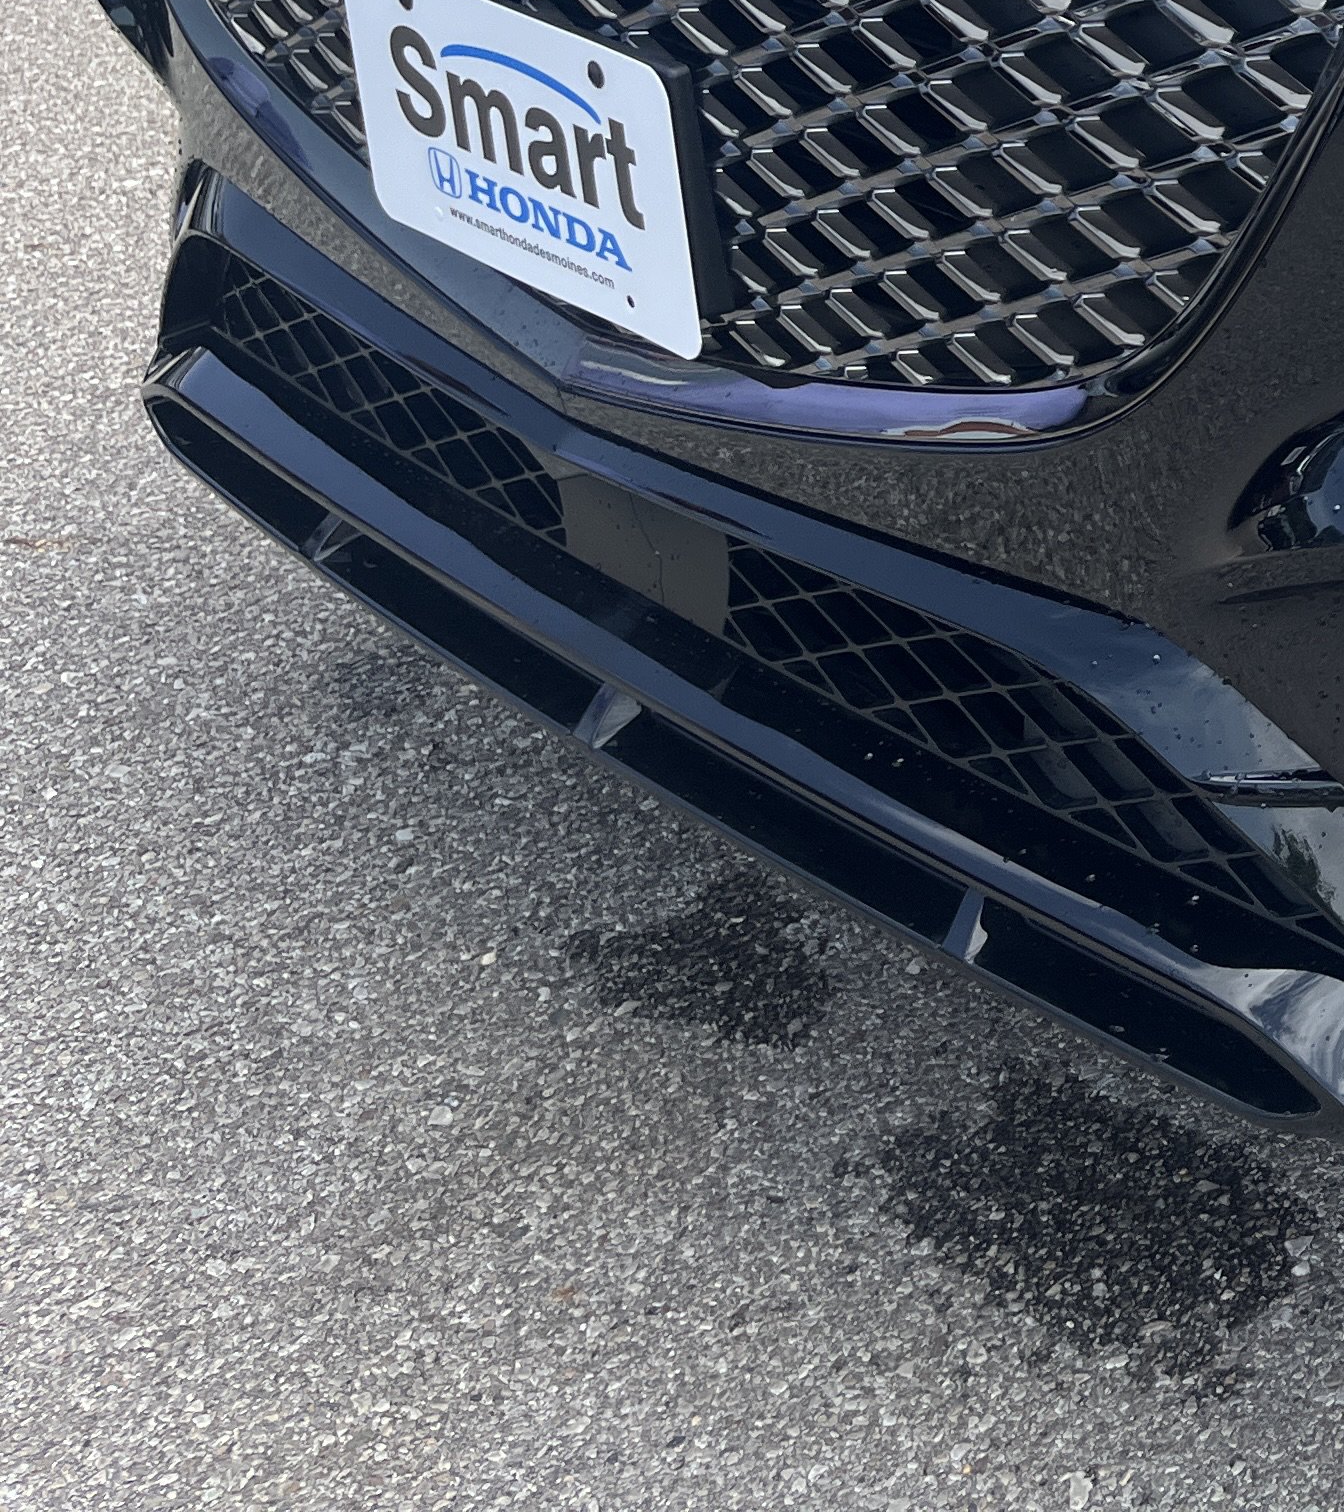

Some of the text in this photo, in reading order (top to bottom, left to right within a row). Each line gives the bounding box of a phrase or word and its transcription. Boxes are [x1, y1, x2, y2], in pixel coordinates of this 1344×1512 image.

[389, 24, 646, 231] Smart
[449, 206, 616, 290] www.smarthondadesmoines.com
[464, 168, 633, 273] HONDA
